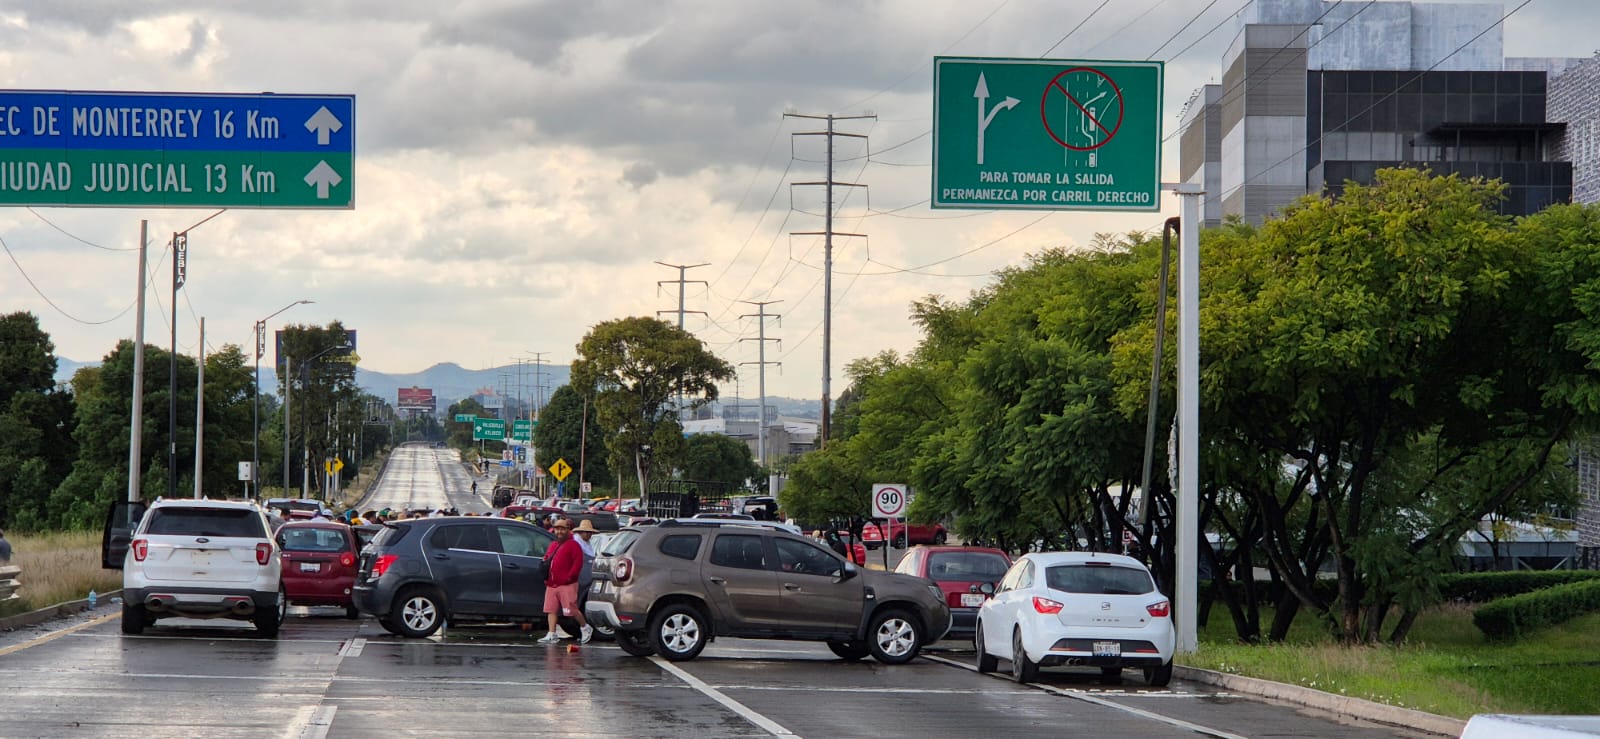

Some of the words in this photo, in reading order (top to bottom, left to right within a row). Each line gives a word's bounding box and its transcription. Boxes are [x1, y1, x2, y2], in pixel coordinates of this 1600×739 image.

[33, 106, 60, 136] DE
[72, 106, 202, 139] MONTERREY
[213, 109, 235, 139] 16
[247, 110, 279, 139] Km
[1, 161, 72, 191] IUDAD
[84, 162, 192, 193] JUDICIAL
[204, 164, 227, 193] 13
[241, 164, 276, 193] Km
[980, 171, 1008, 184] PARA
[1012, 172, 1051, 185] TOMAR
[1056, 173, 1070, 185] LA
[1075, 173, 1114, 186] SALIDA
[943, 188, 1018, 201] PERMANEZCA
[1023, 190, 1047, 202] POR
[1051, 190, 1092, 203] CARRIL
[1097, 191, 1150, 204] DERECHO
[177, 235, 186, 283] PUEBLA
[881, 492, 898, 504] 90
